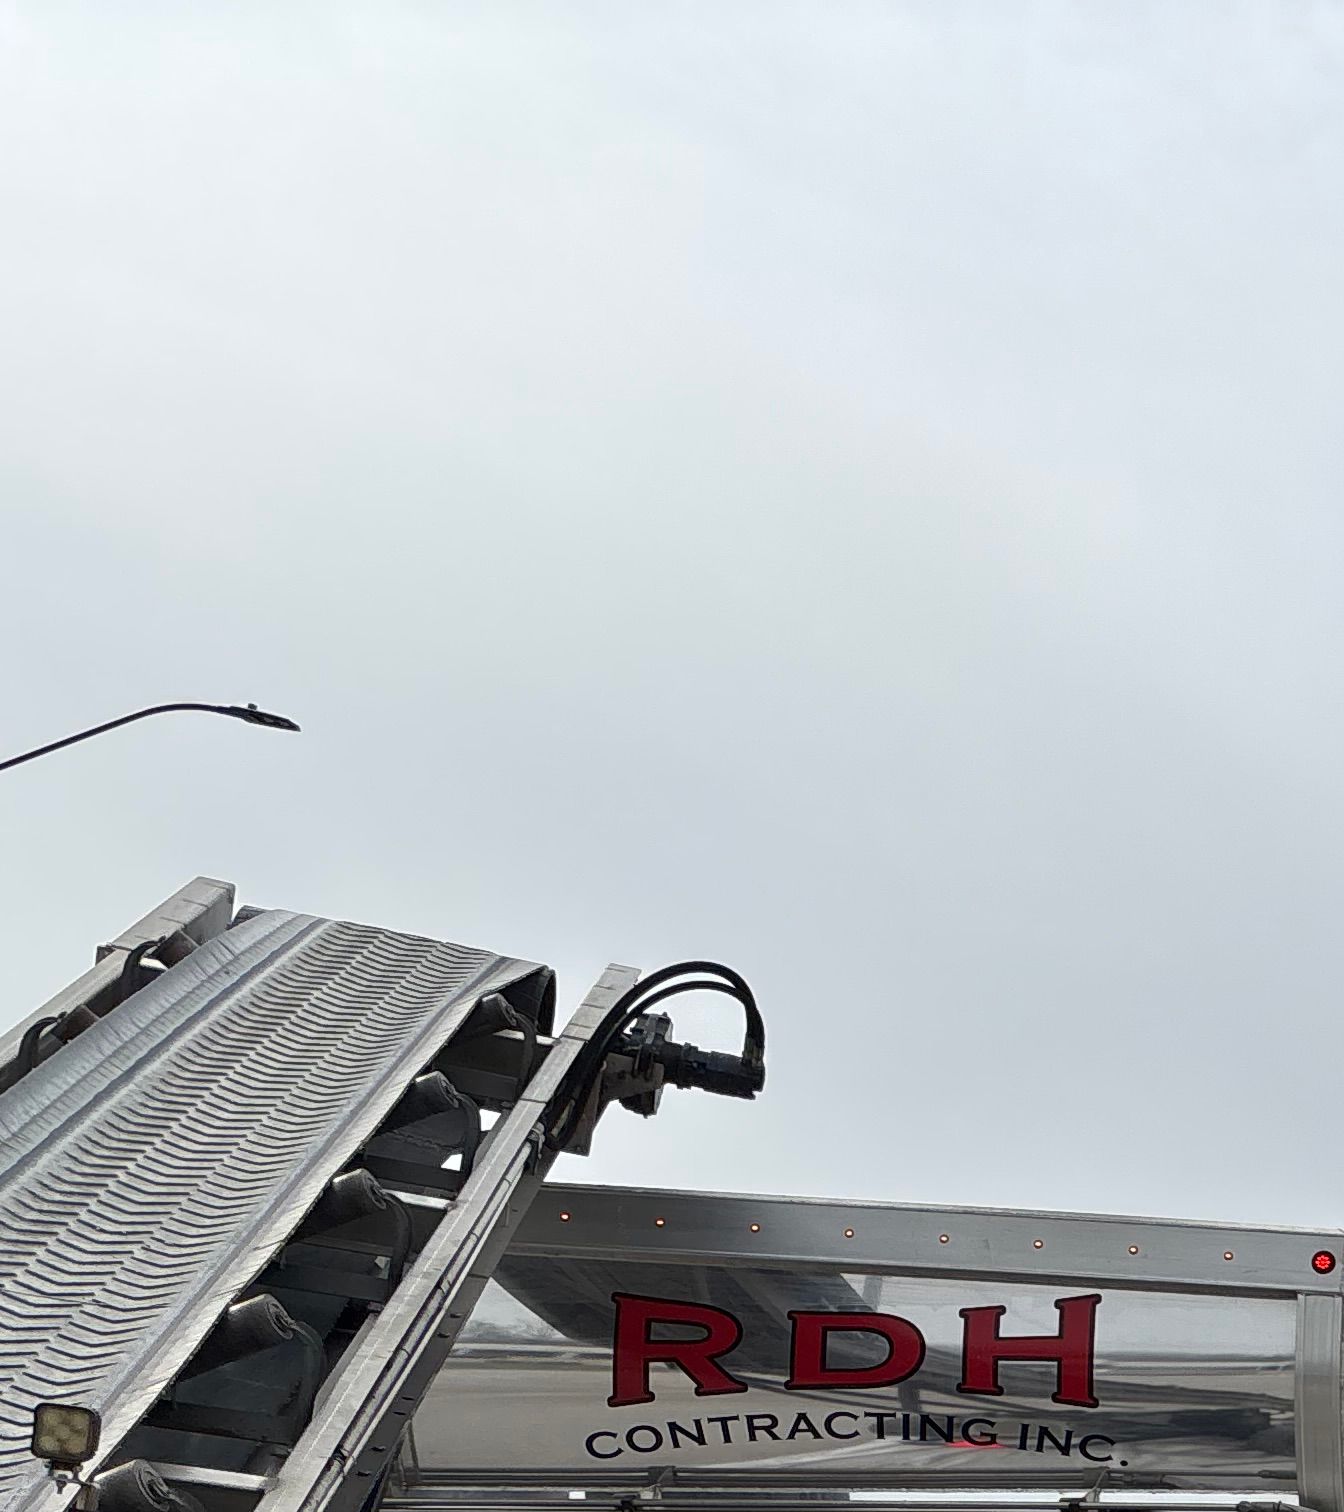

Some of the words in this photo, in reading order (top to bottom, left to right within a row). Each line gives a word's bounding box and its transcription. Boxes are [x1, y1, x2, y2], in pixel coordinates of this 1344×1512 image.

[607, 1291, 1102, 1408] RDH
[585, 1410, 999, 1460] CONTRACTING
[1017, 1423, 1129, 1467] INC.
